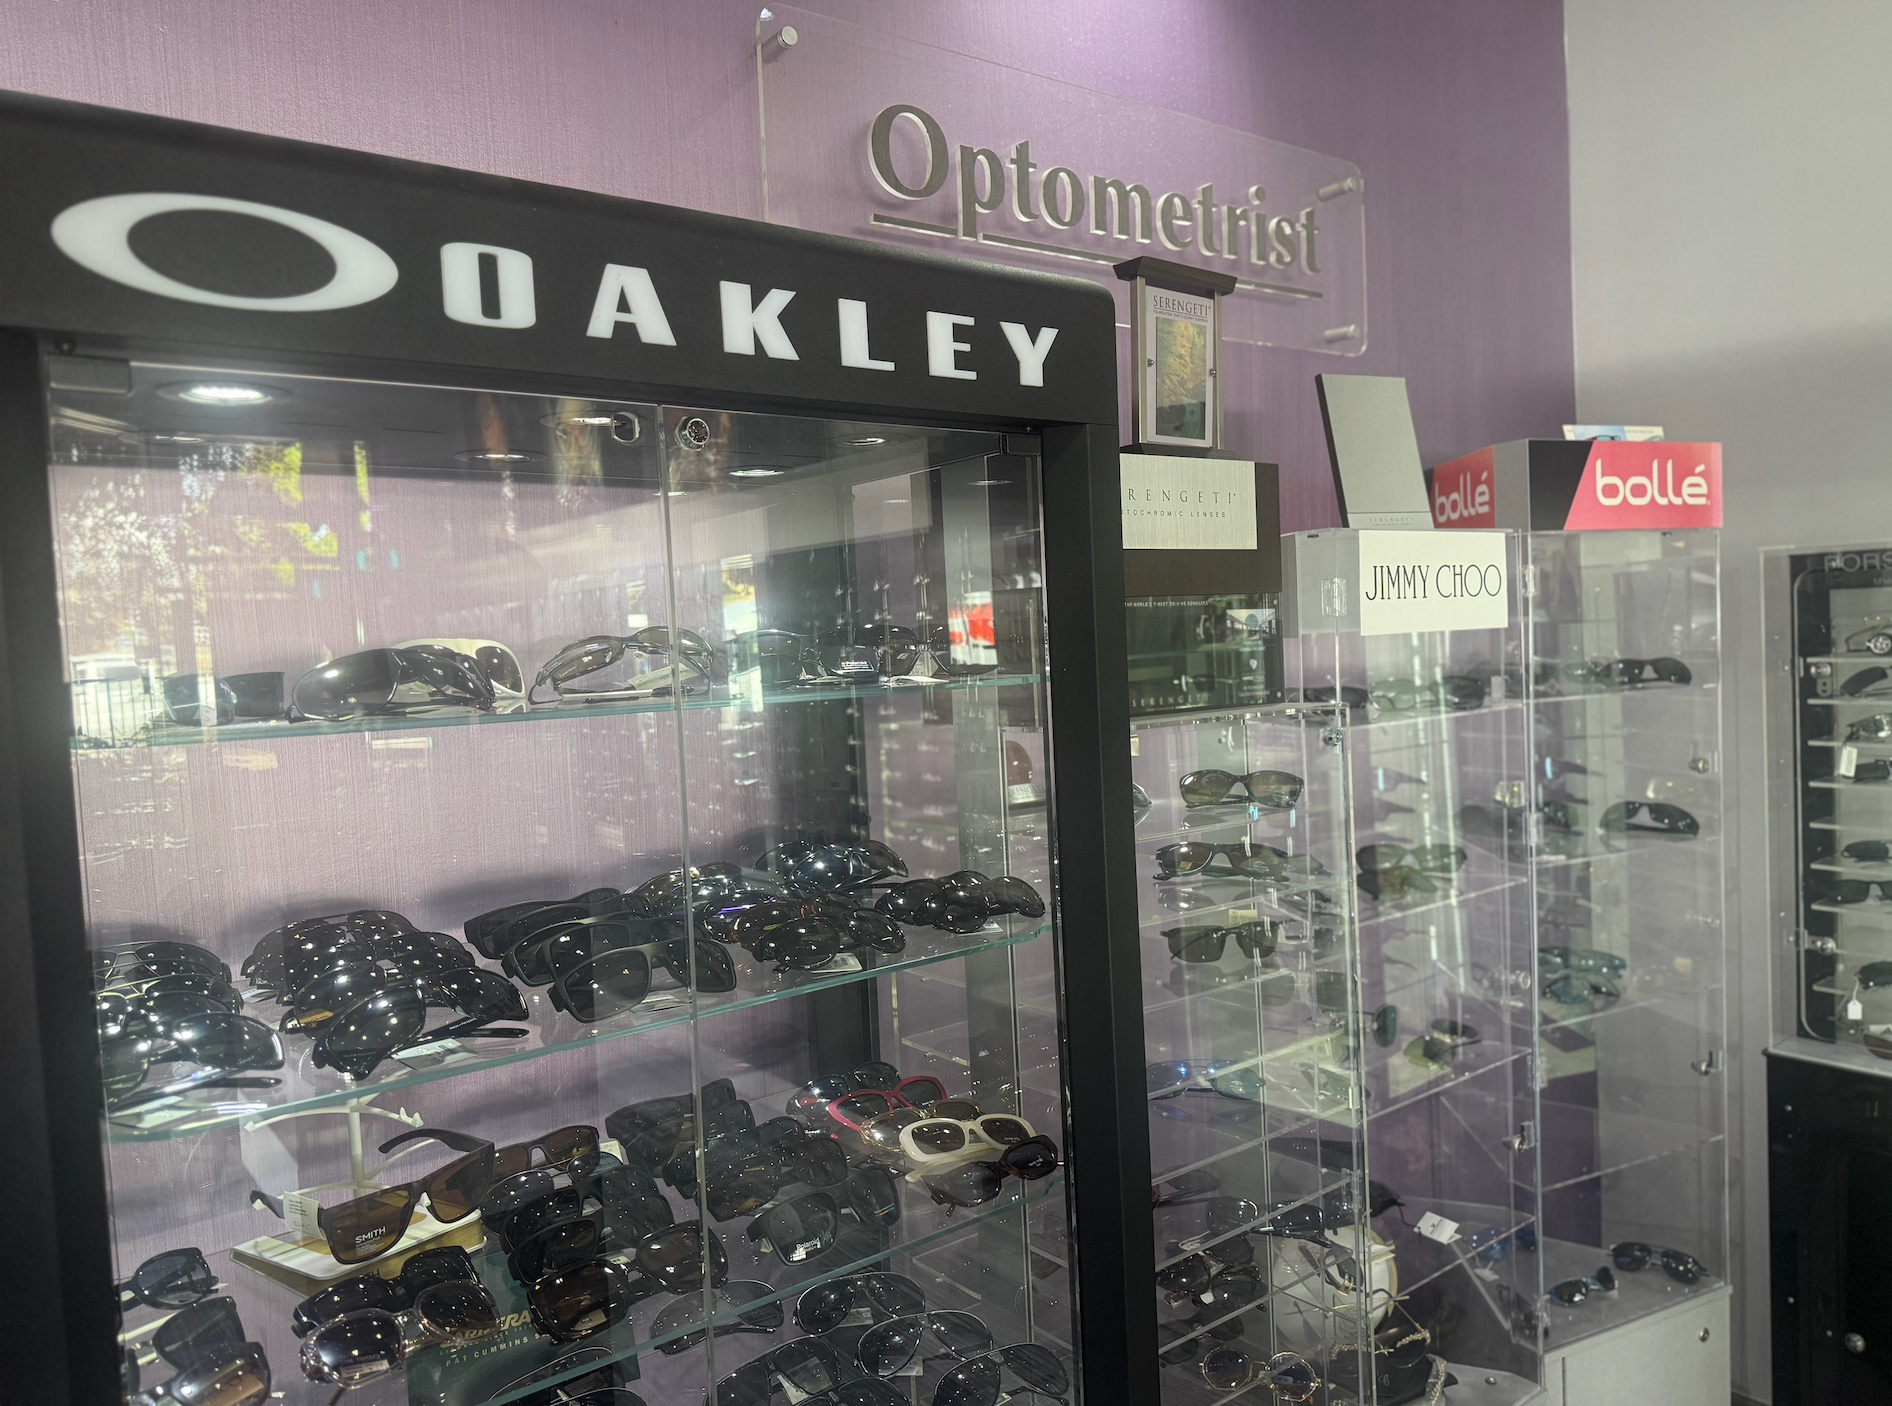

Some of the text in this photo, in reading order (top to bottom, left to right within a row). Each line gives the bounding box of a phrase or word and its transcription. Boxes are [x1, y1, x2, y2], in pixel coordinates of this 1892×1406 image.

[868, 104, 1322, 275] Optometrist
[440, 241, 1060, 387] OAKLEY
[1153, 294, 1208, 316] SERENGETI
[1435, 470, 1490, 523] bollé
[1596, 458, 1708, 506] bollé
[1365, 564, 1502, 601] JIMMY CHOO
[355, 1226, 386, 1244] SMITH
[446, 1355, 467, 1367] PAT
[474, 1336, 529, 1358] CUMMINS
